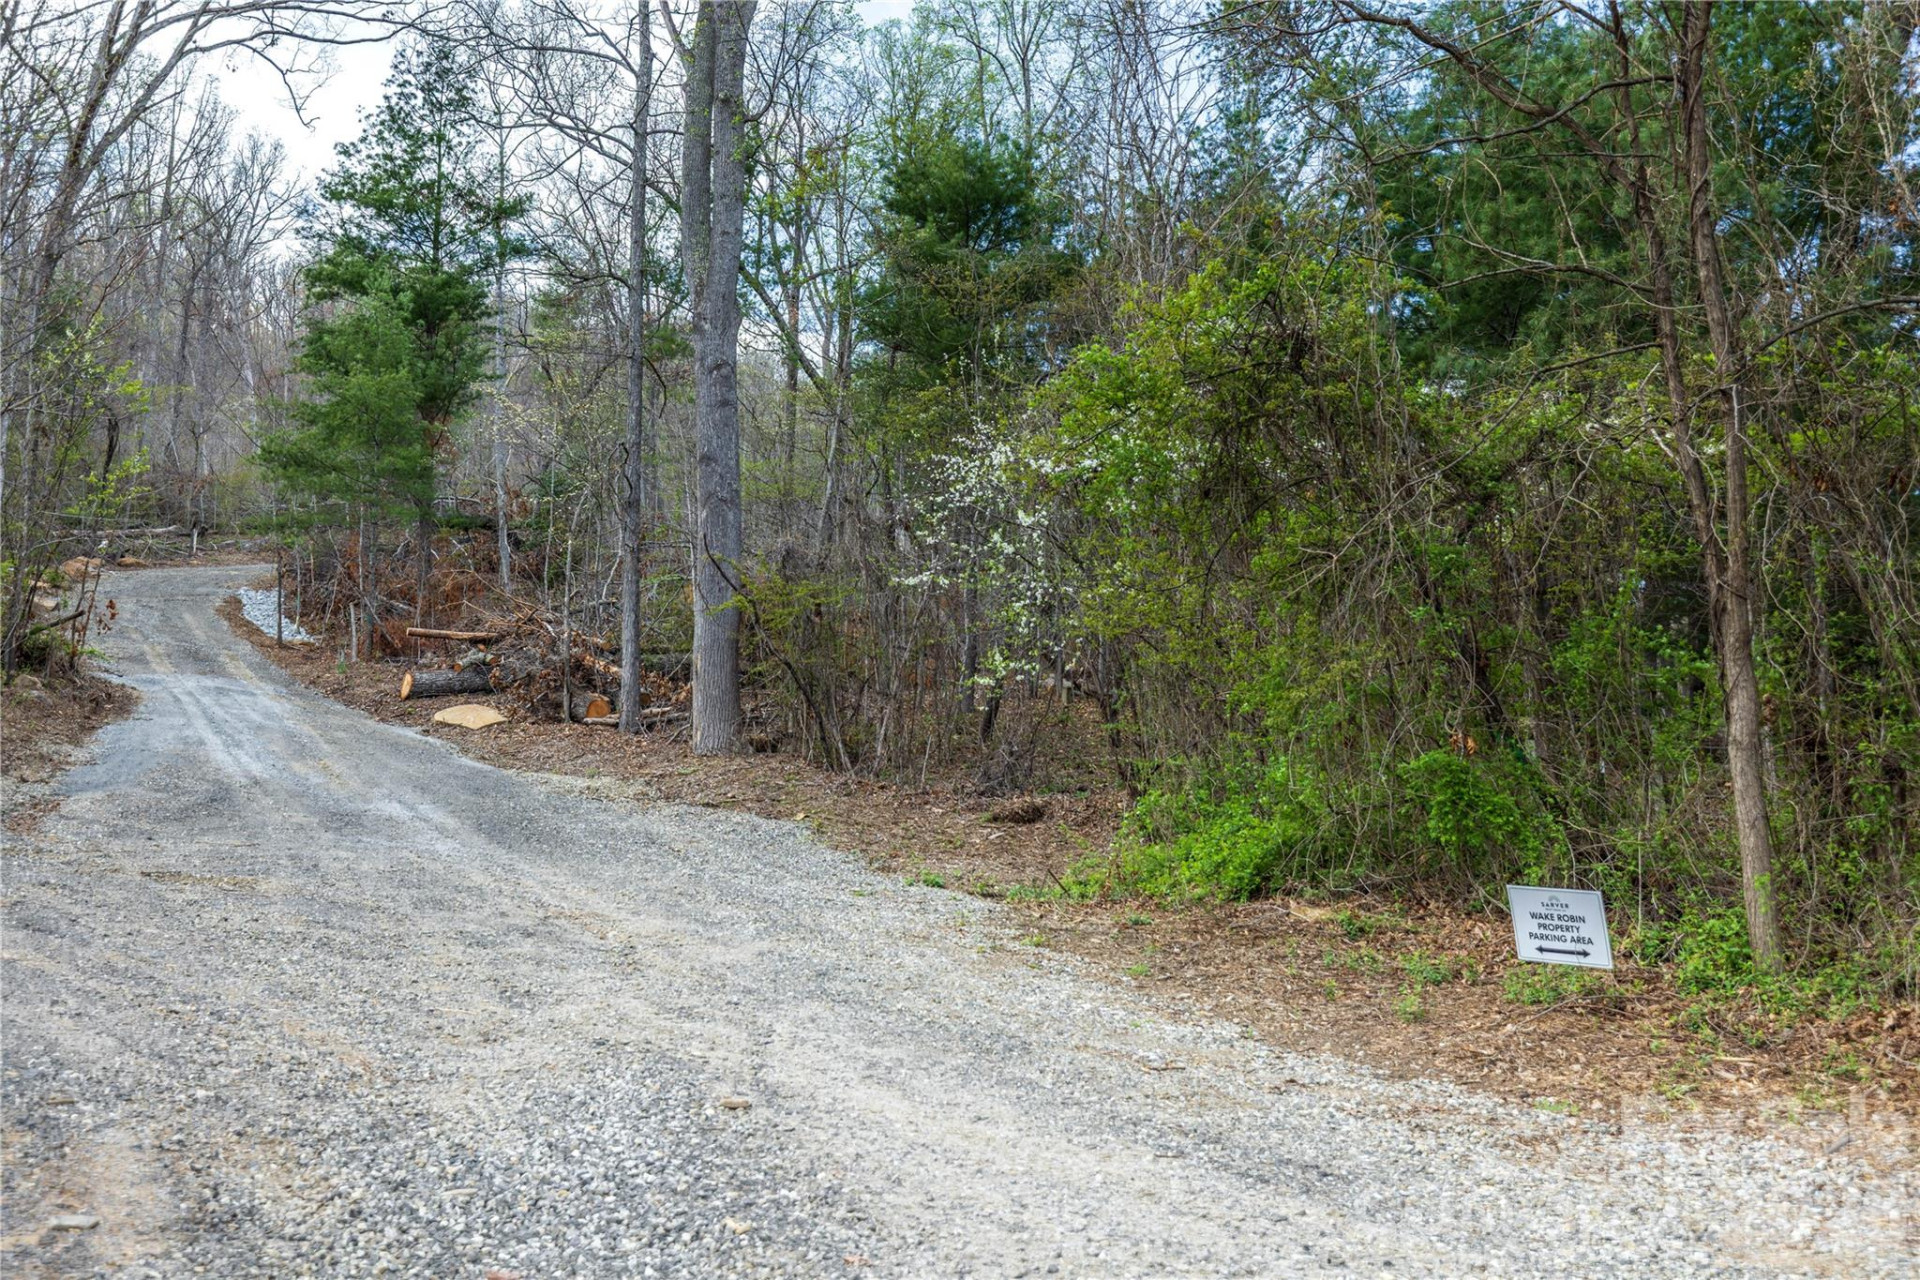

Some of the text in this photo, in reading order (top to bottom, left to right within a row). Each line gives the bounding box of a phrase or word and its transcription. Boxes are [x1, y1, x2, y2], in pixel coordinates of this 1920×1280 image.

[1529, 911, 1586, 924] WAKE ROBIN
[1537, 922, 1580, 934] PROPERTY
[1528, 932, 1593, 945] PARKING AREA
